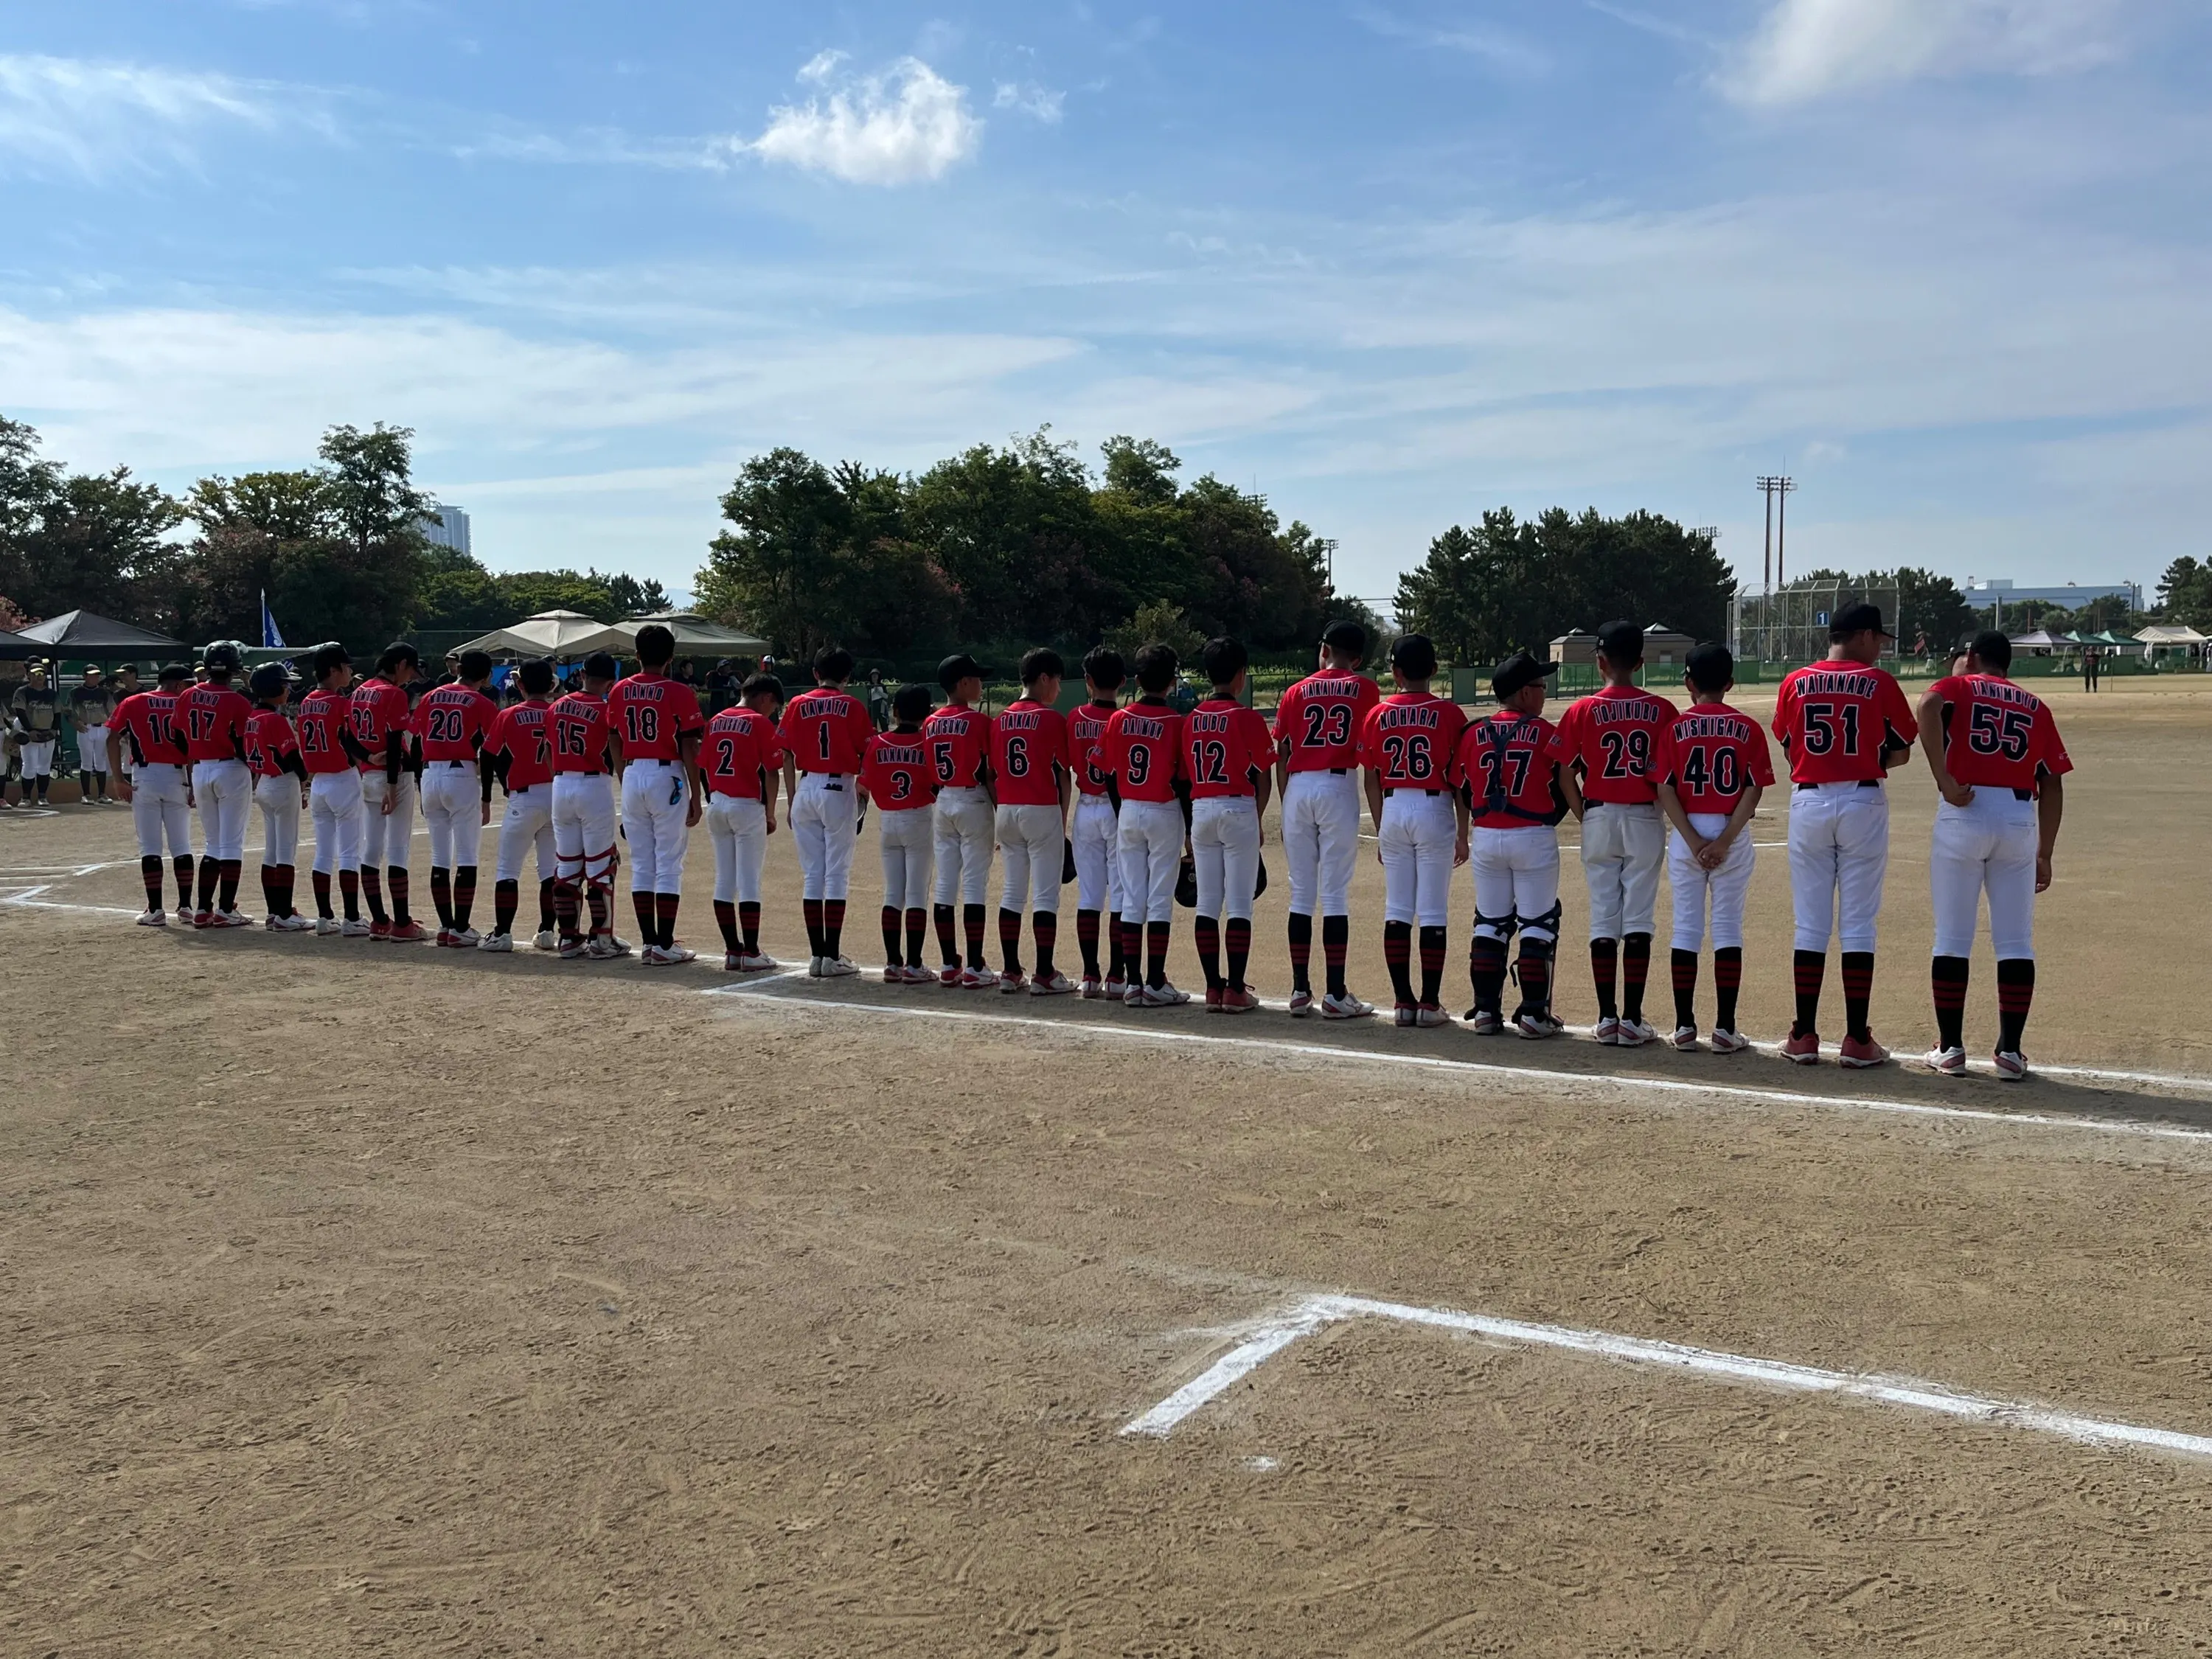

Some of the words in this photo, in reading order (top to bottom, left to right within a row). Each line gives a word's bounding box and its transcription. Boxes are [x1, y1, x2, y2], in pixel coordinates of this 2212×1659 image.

[1820, 613, 1824, 625] 1
[623, 685, 664, 701] BANNO
[1301, 681, 1360, 700] TAKAYAMA
[1795, 672, 1878, 700] WATANABE
[1971, 680, 2040, 712] TANIMOTO
[188, 709, 216, 740] 17
[352, 708, 380, 742] 22
[427, 709, 464, 742] 20
[625, 706, 659, 742] 18
[800, 698, 849, 720] KAWATA
[1001, 713, 1040, 731] TAKAI
[1192, 714, 1228, 733] KUBO
[1301, 703, 1354, 748] 23
[1380, 707, 1439, 731] NOHARA
[1592, 700, 1660, 726] TOJIKUBO
[302, 719, 329, 752] 21
[556, 720, 587, 756] 15
[818, 721, 830, 760] 1
[1672, 717, 1750, 744] NISHIGAKI
[1804, 703, 1860, 757] 51
[1969, 702, 2034, 762] 55
[247, 738, 265, 770] 4
[714, 739, 734, 776] 2
[876, 746, 926, 767] KANAMOR
[934, 742, 956, 782] 5
[1005, 737, 1030, 777] 6
[1127, 743, 1150, 785] 9
[1192, 740, 1230, 784] 12
[1382, 734, 1434, 780] 26
[1600, 729, 1650, 779] 29
[1683, 745, 1741, 796] 40
[891, 770, 913, 800] 3
[1479, 749, 1534, 798] 27
